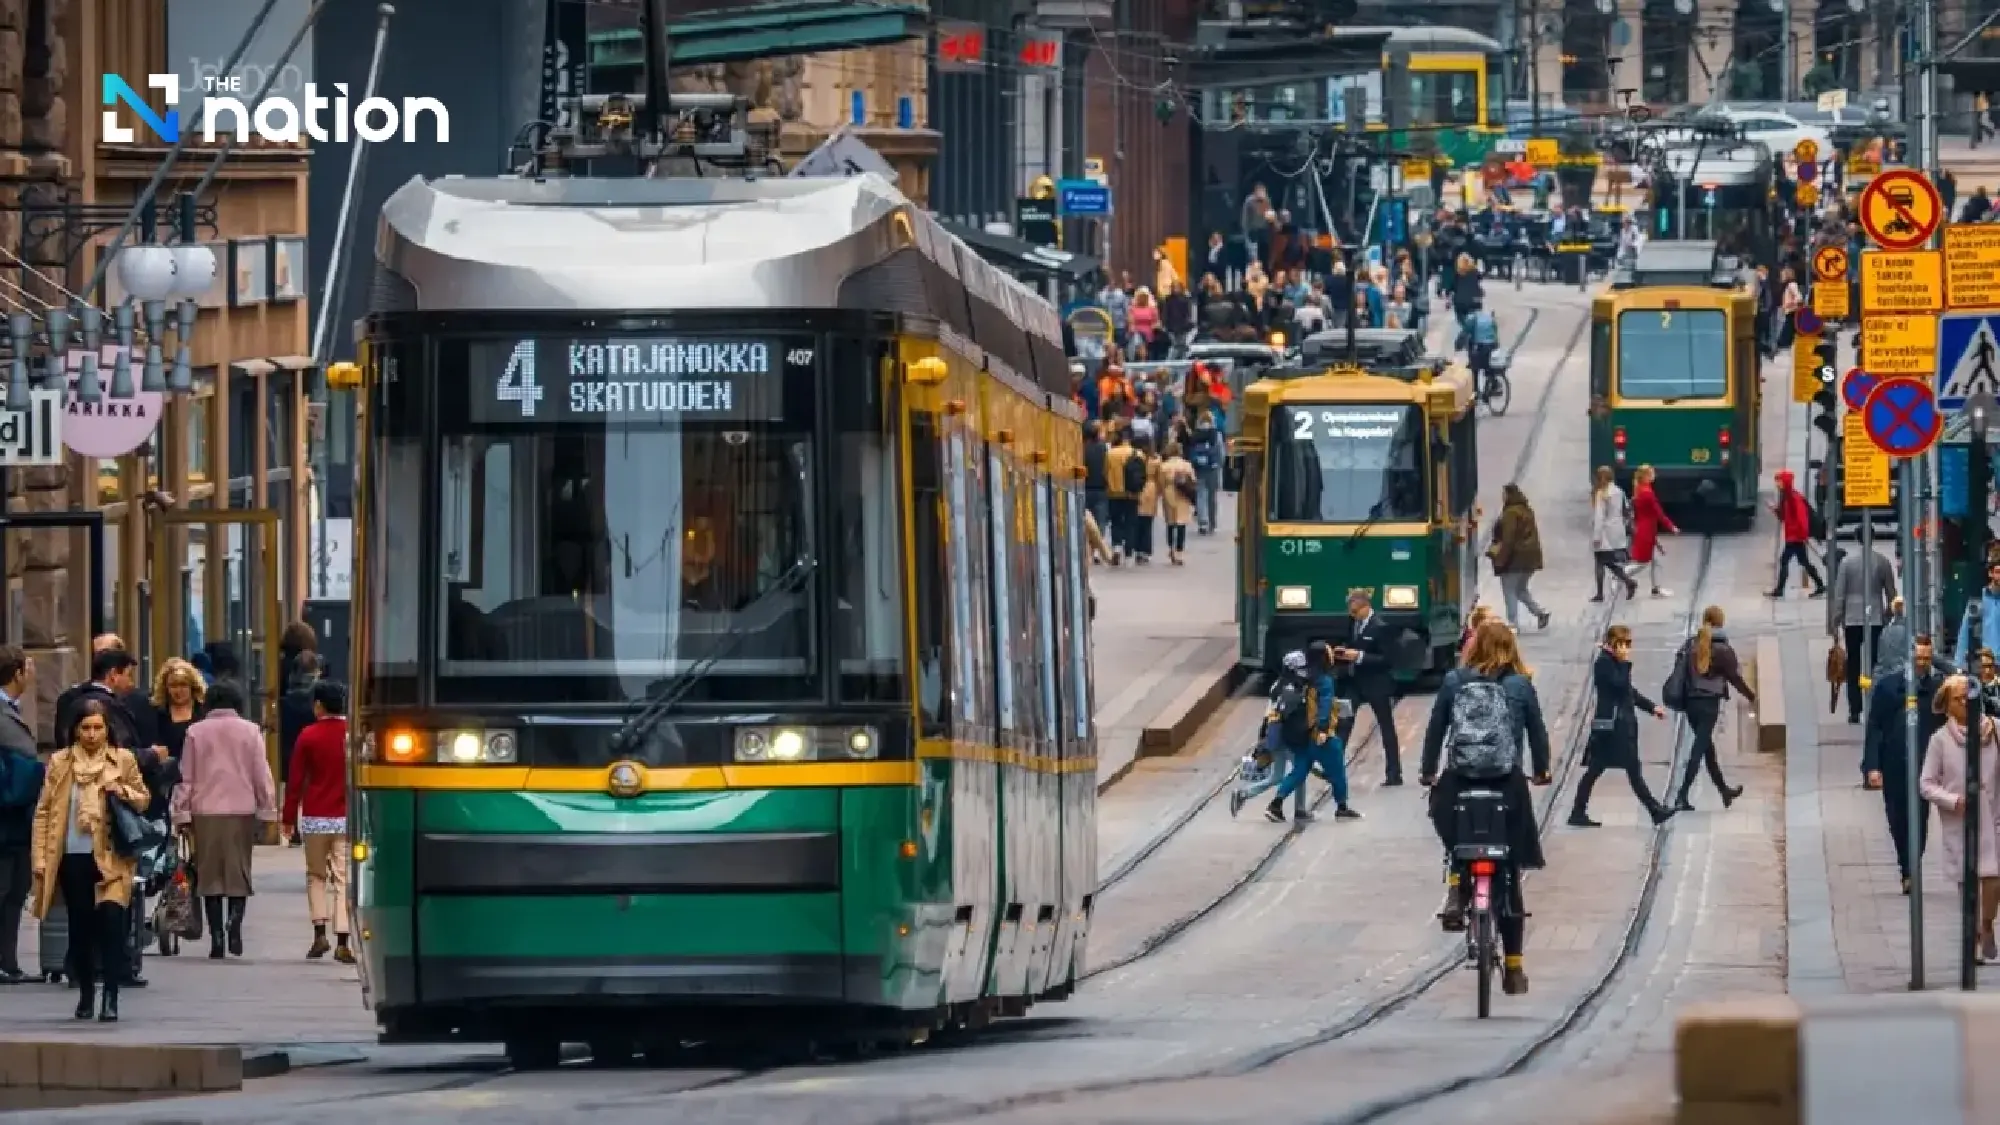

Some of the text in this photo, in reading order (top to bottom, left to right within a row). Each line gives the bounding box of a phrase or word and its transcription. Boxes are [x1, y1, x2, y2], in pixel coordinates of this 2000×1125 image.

[568, 344, 768, 374] KATAJANOKKA
[786, 350, 813, 365] 407
[497, 340, 543, 416] 4
[570, 381, 732, 411] SKATUDDEN
[1293, 410, 1313, 440] 2
